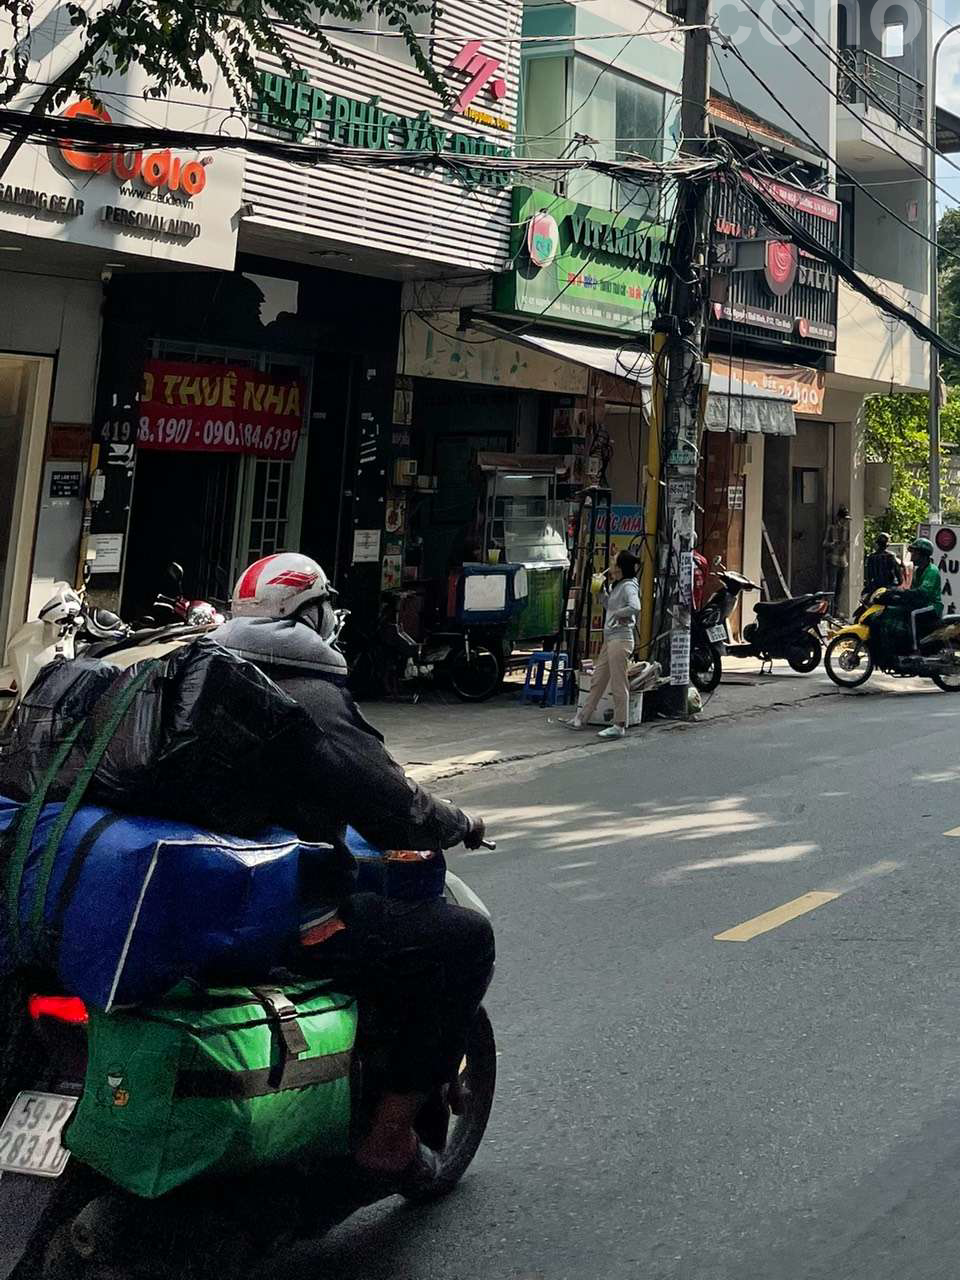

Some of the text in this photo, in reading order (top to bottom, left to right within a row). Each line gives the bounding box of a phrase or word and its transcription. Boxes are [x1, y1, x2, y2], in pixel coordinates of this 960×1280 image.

[49, 194, 85, 216] GEAR
[105, 205, 201, 238] PERSONAL AUDIO
[570, 213, 648, 263] VITAMIN
[162, 369, 238, 407] THUÊ
[100, 421, 131, 442] 419
